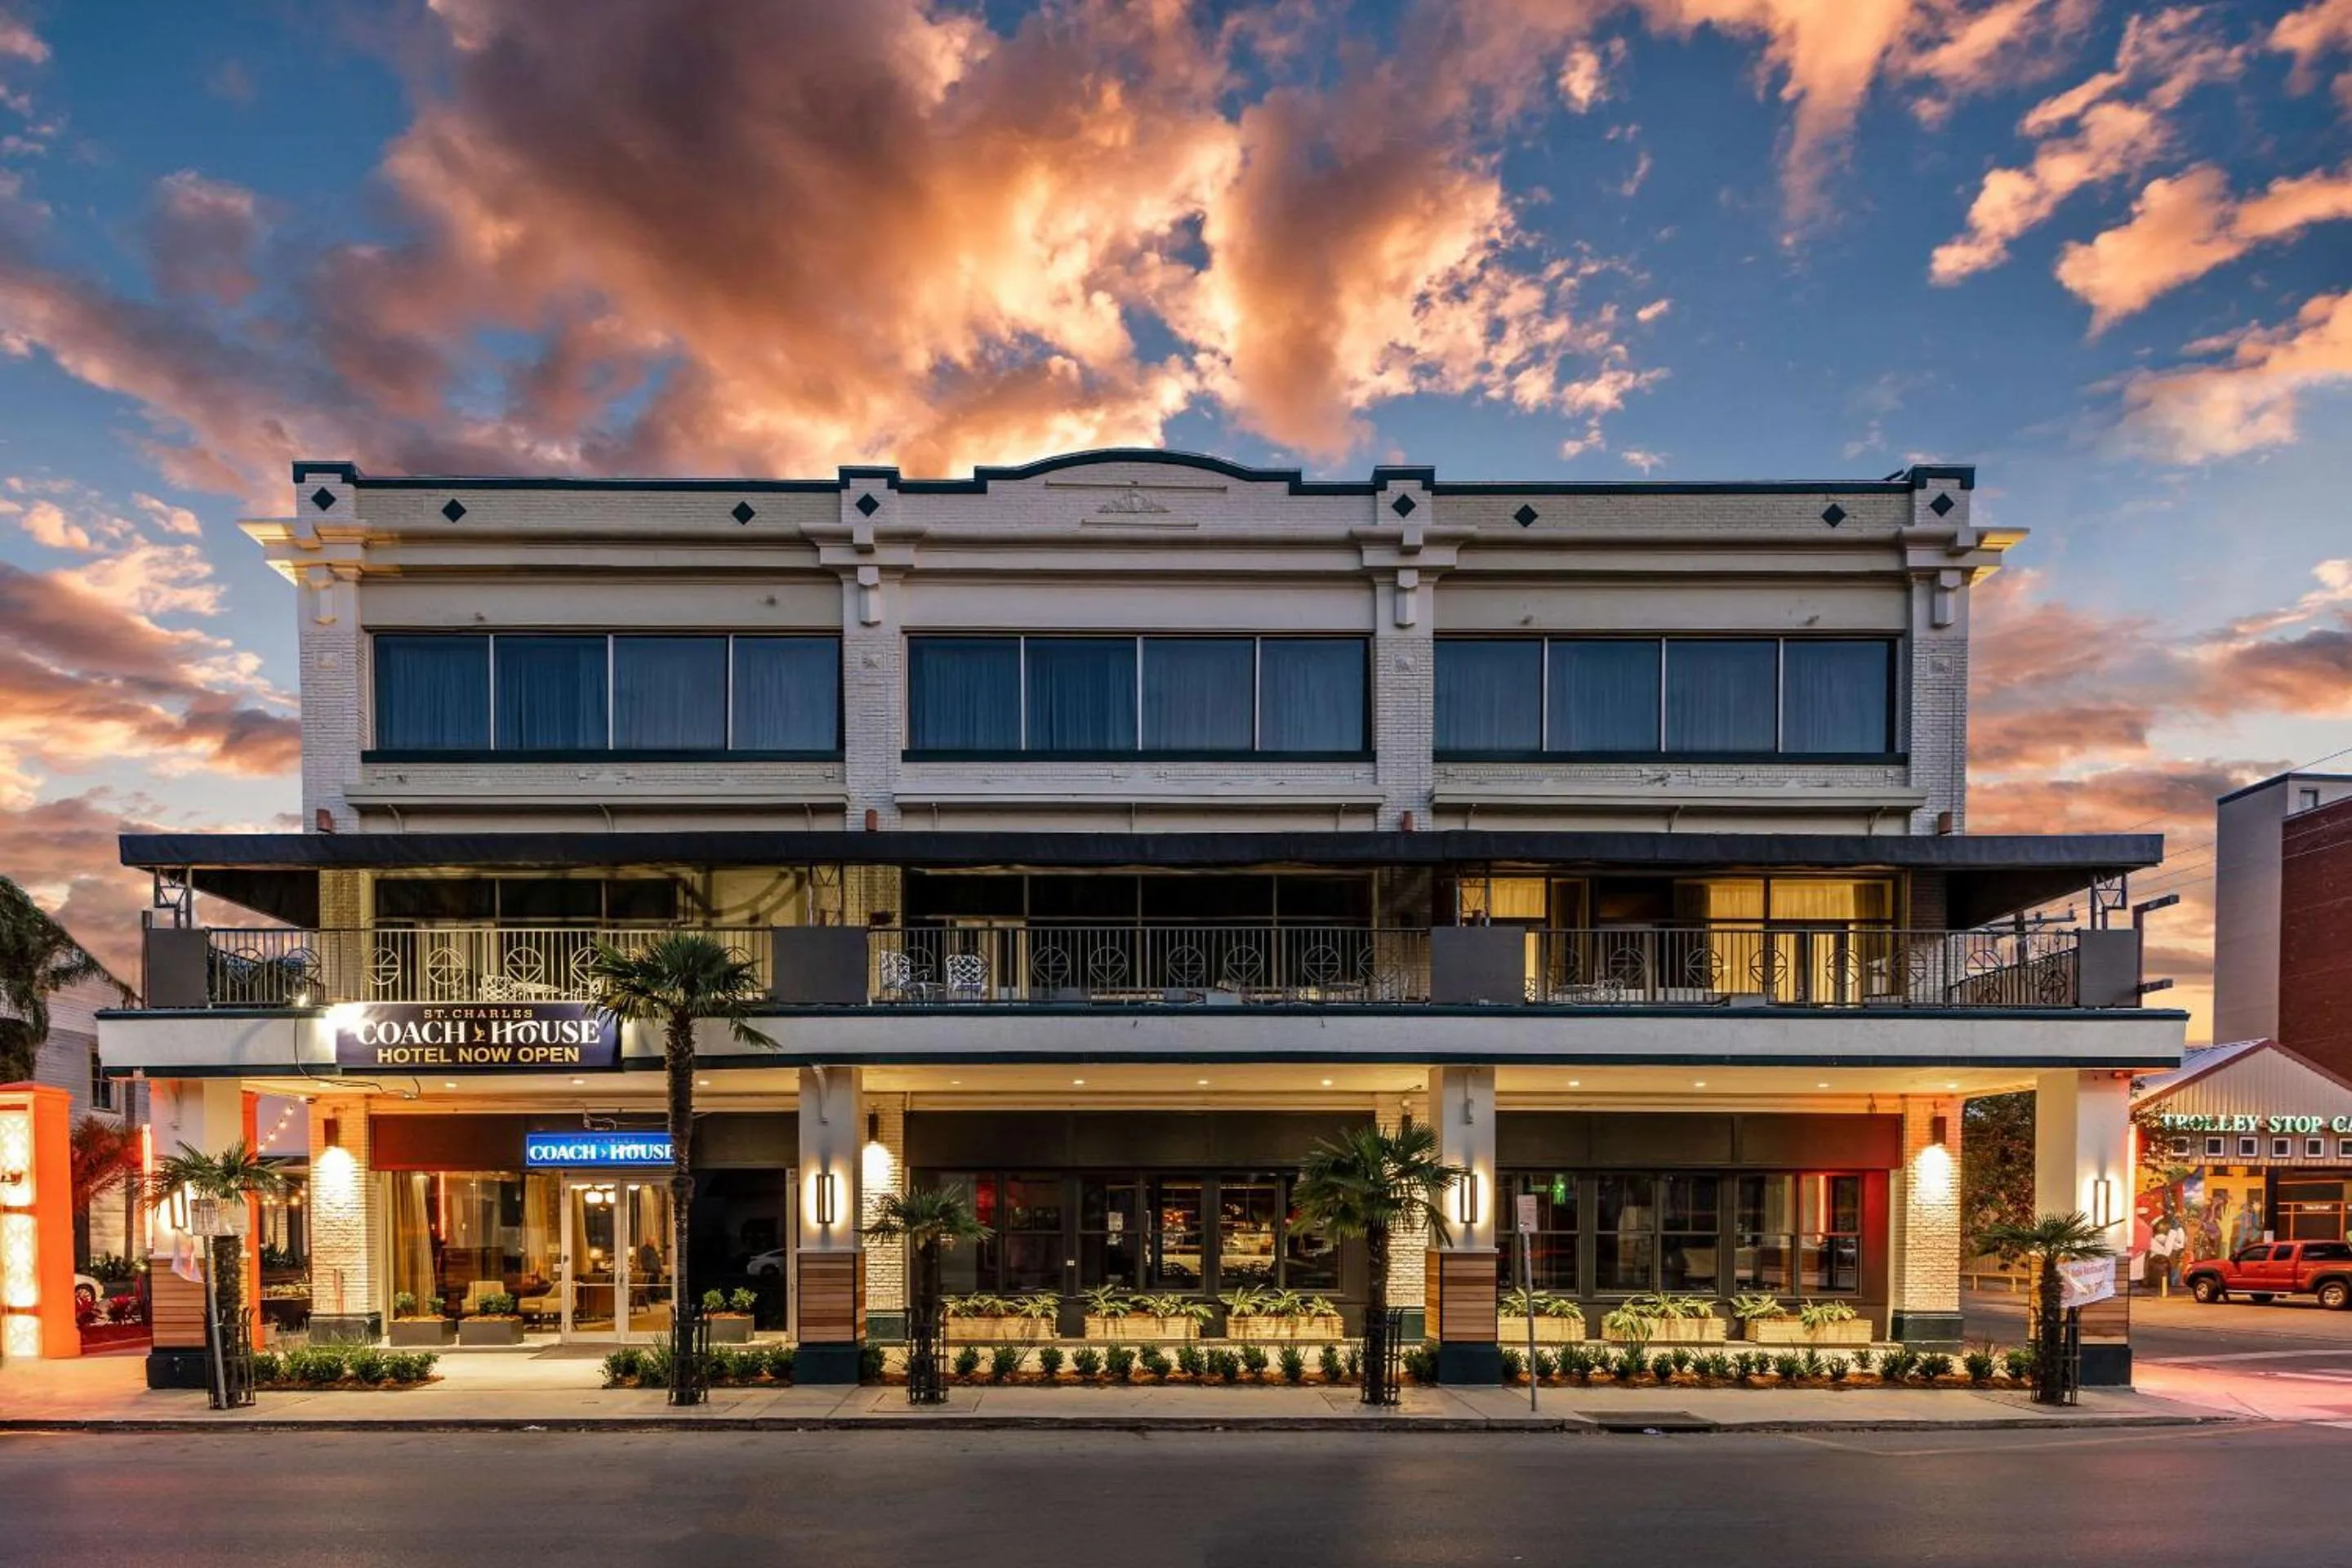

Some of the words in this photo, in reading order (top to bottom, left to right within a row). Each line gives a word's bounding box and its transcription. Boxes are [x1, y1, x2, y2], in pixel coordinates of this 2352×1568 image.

[424, 1009, 448, 1018] ST.
[452, 1009, 533, 1019] CHARLES
[356, 1020, 466, 1045] COACH
[491, 1020, 600, 1045] HOUSE
[377, 1048, 452, 1063] HOTEL
[458, 1048, 511, 1063] NOW
[517, 1047, 580, 1063] OPEN
[2160, 1114, 2261, 1132] TROLLEY
[2269, 1116, 2323, 1133] STOP
[530, 1144, 597, 1160] COACH
